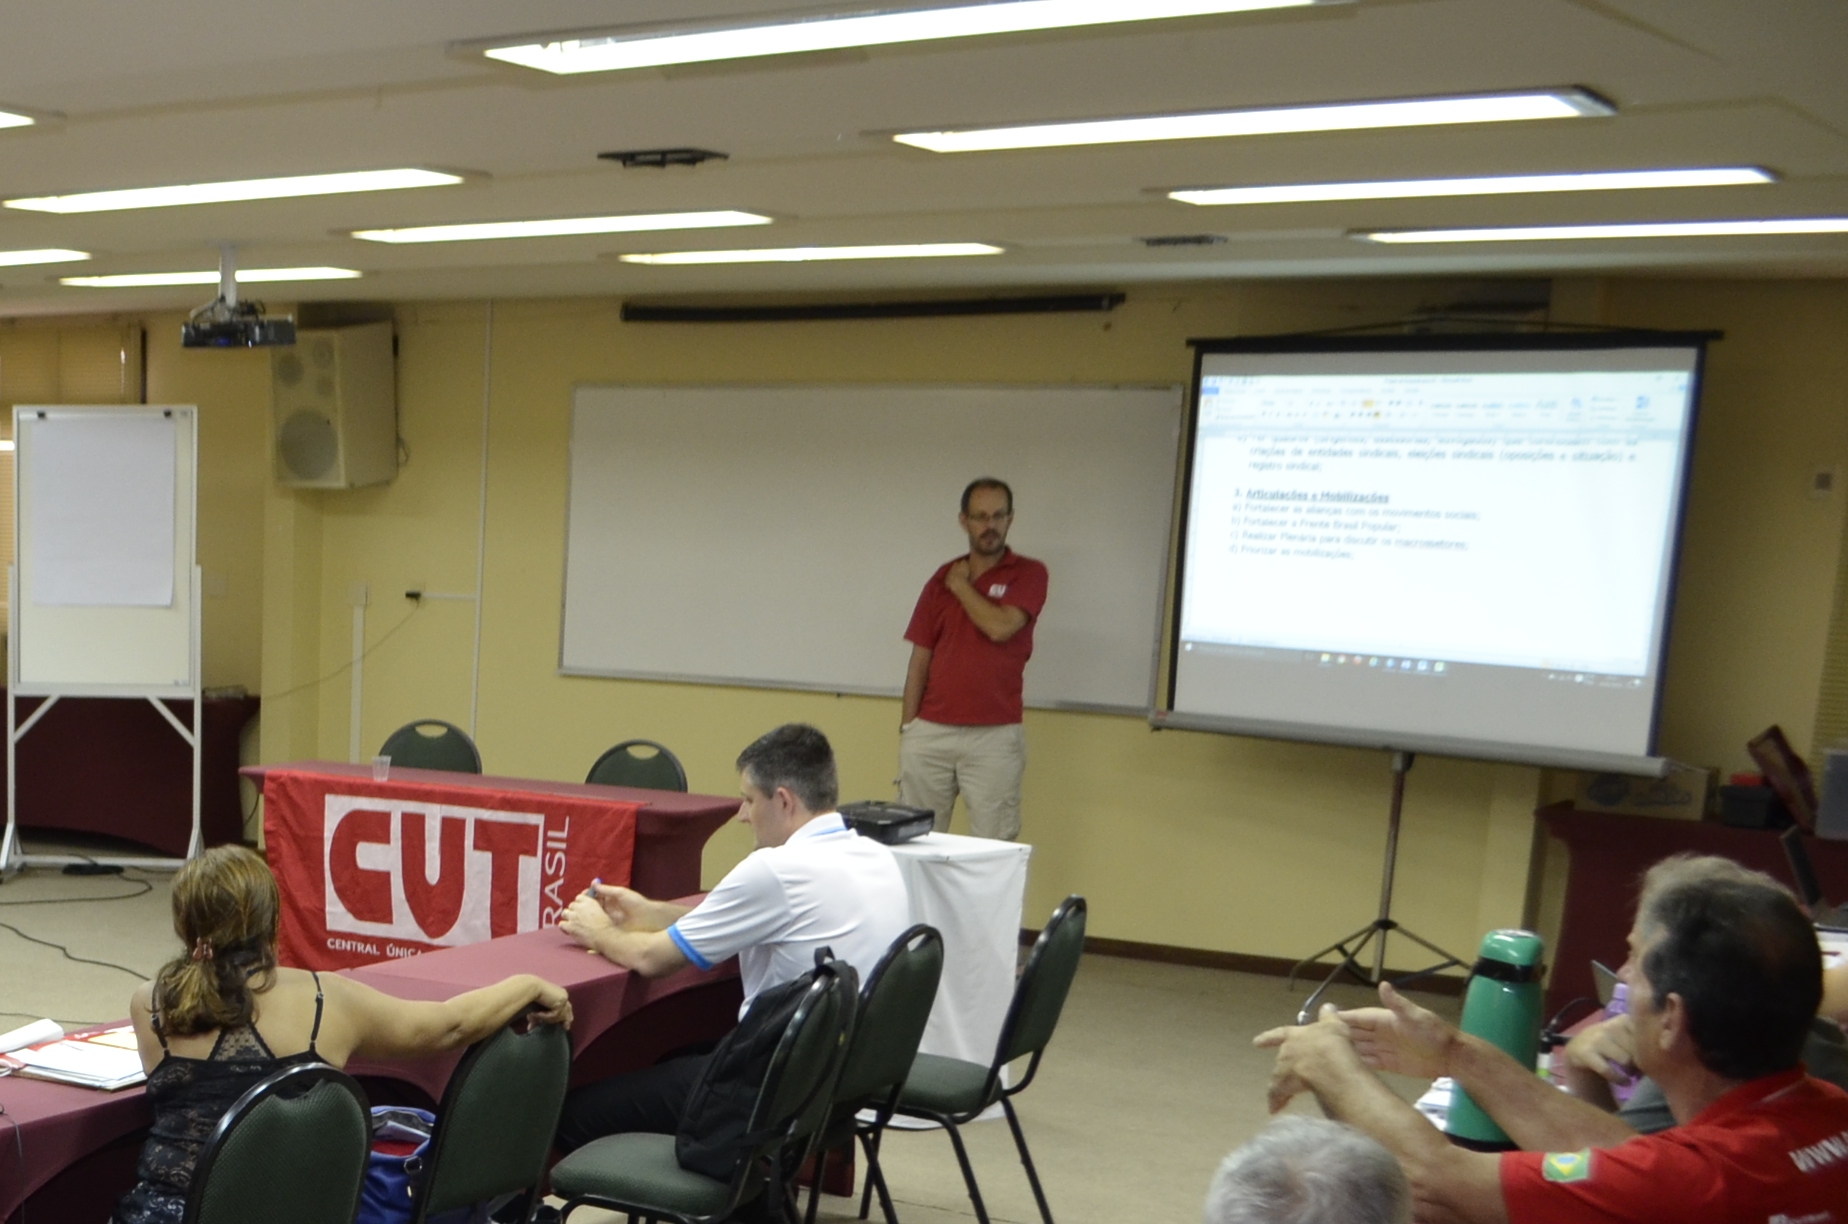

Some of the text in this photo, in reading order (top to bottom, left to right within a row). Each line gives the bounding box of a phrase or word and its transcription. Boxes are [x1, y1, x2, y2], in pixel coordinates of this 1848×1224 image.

[1246, 488, 1308, 502] Articulações
[1319, 489, 1390, 504] Mobilizações
[1244, 502, 1290, 513] Fortalecer
[1305, 503, 1343, 517] alianças
[1345, 507, 1366, 516] com
[1368, 508, 1380, 517] os
[1382, 507, 1442, 519] movimentos
[1243, 516, 1288, 527] Fortalecer
[1299, 517, 1330, 529] Frente
[1333, 518, 1359, 530] Brasil
[1242, 530, 1277, 541] Realizar
[1280, 530, 1317, 543] Plenária
[1319, 535, 1341, 545] para
[1343, 534, 1378, 546] discutir
[1240, 545, 1278, 556] Priorizar
[328, 808, 542, 942] CUT
[542, 814, 570, 930] RASIL
[326, 937, 381, 956] CENTRAL
